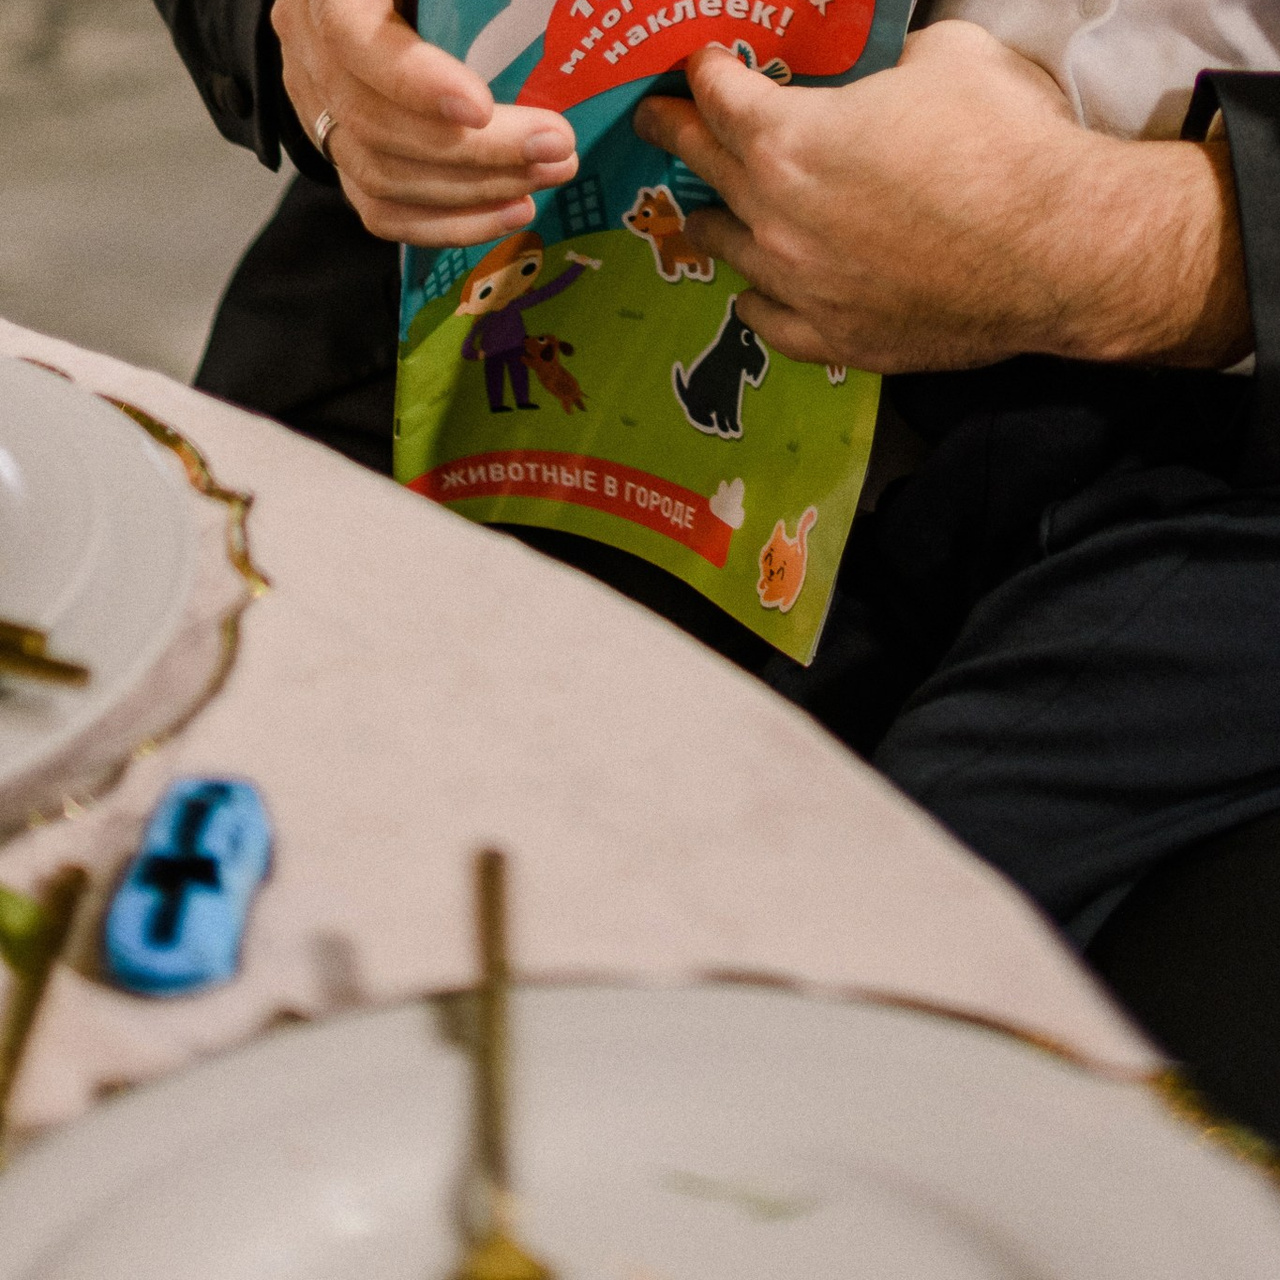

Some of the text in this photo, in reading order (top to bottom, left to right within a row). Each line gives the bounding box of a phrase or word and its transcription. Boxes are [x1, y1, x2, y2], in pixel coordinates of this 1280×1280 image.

[441, 462, 697, 530] ЖИВОТНЫЕ В ГОРОДЕ
